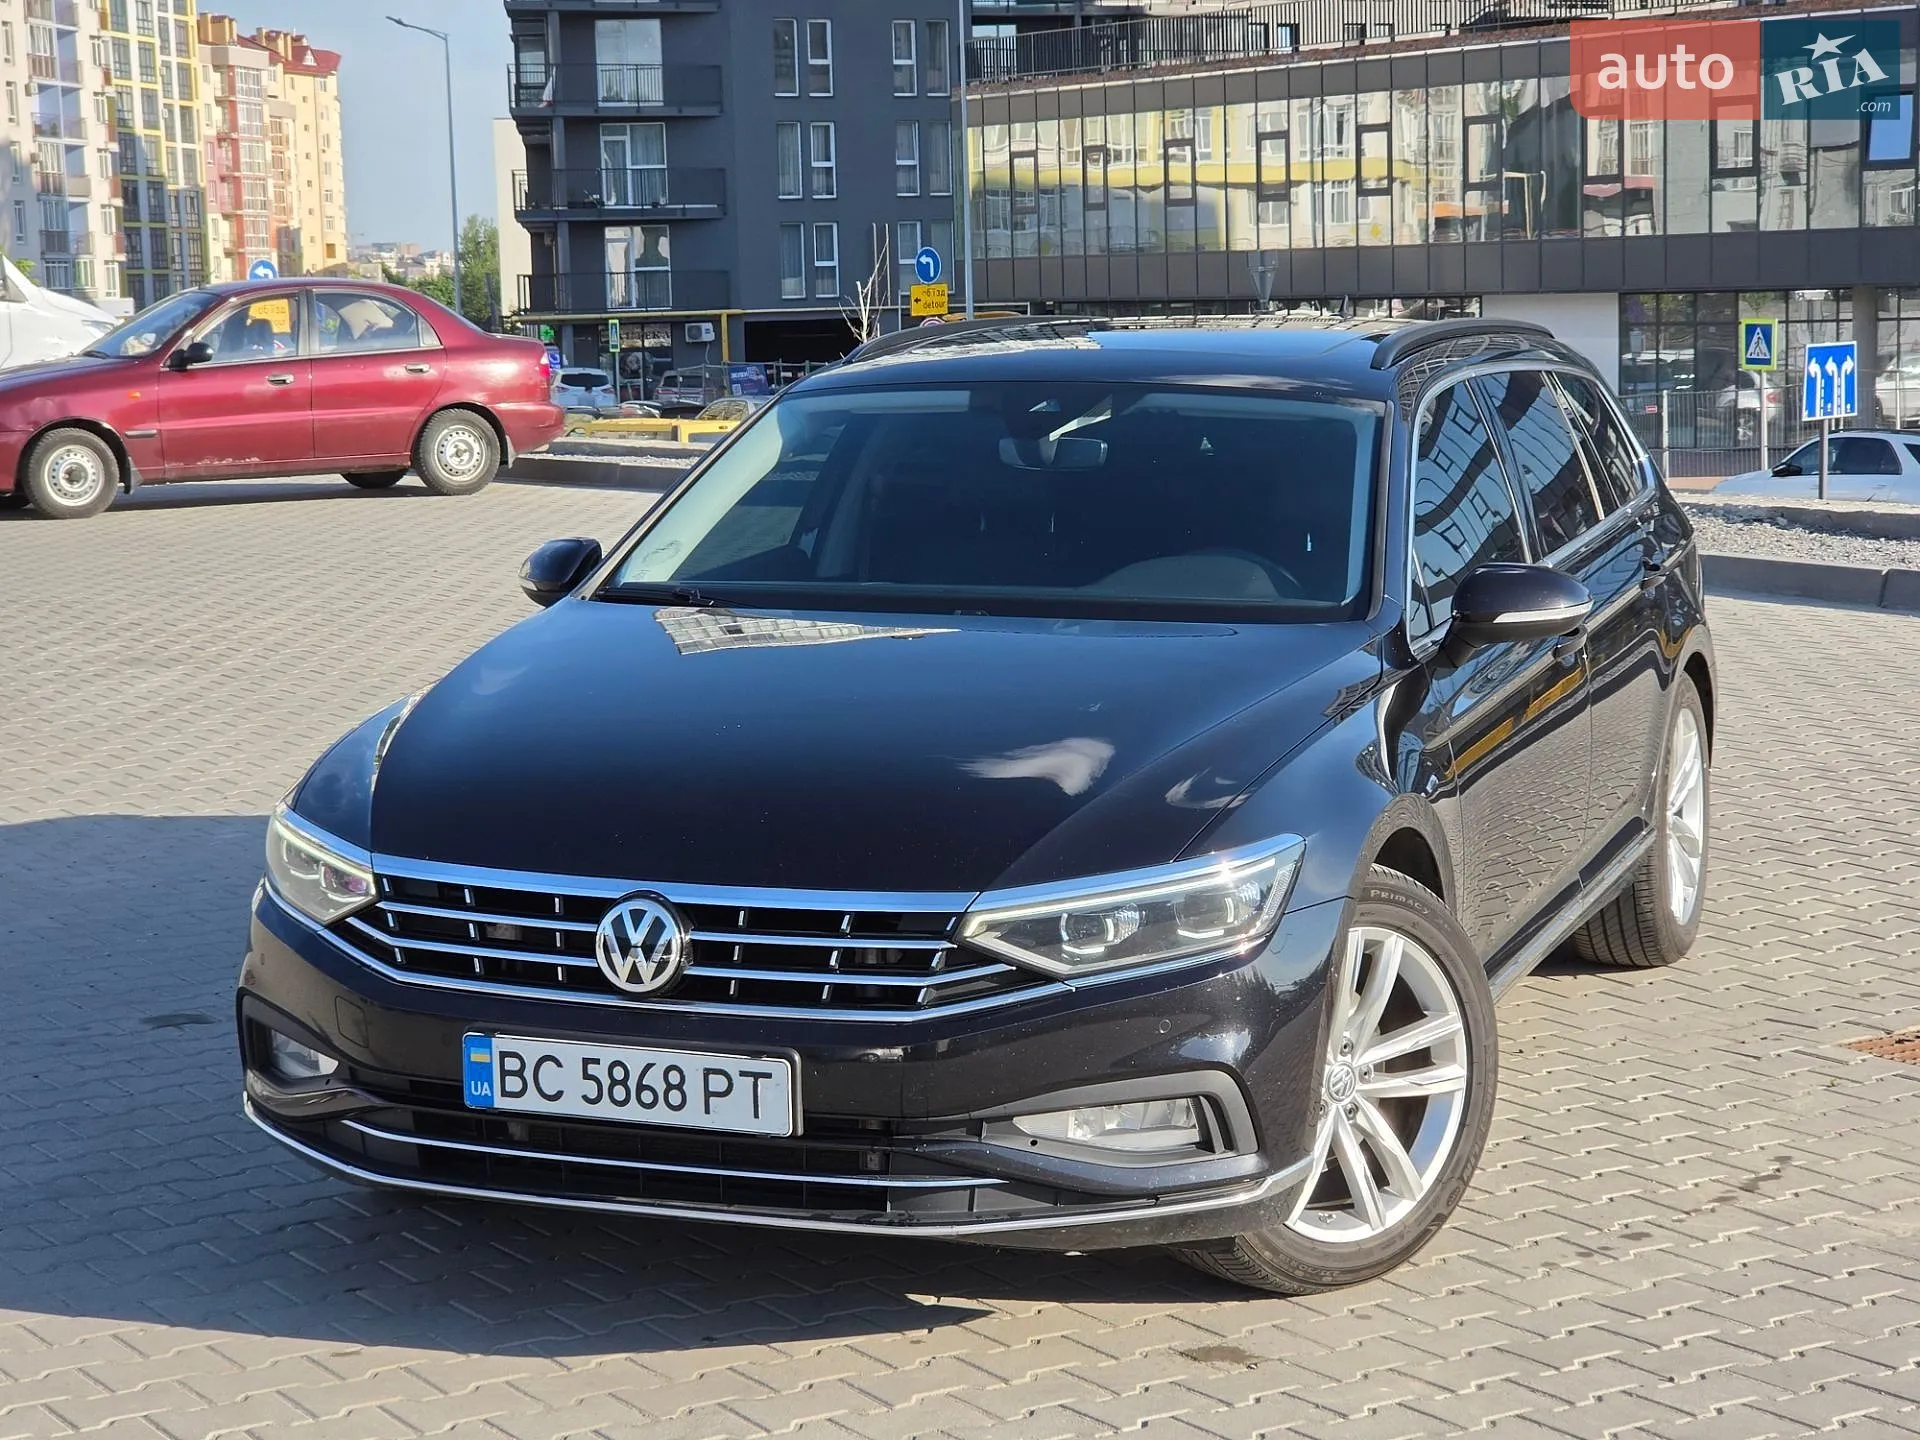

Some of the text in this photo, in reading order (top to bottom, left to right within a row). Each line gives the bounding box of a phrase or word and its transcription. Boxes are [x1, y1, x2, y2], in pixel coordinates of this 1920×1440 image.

[1370, 889, 1431, 914] PRIMACY
[471, 1080, 492, 1097] UA
[499, 1050, 772, 1119] BC 5868 PT
